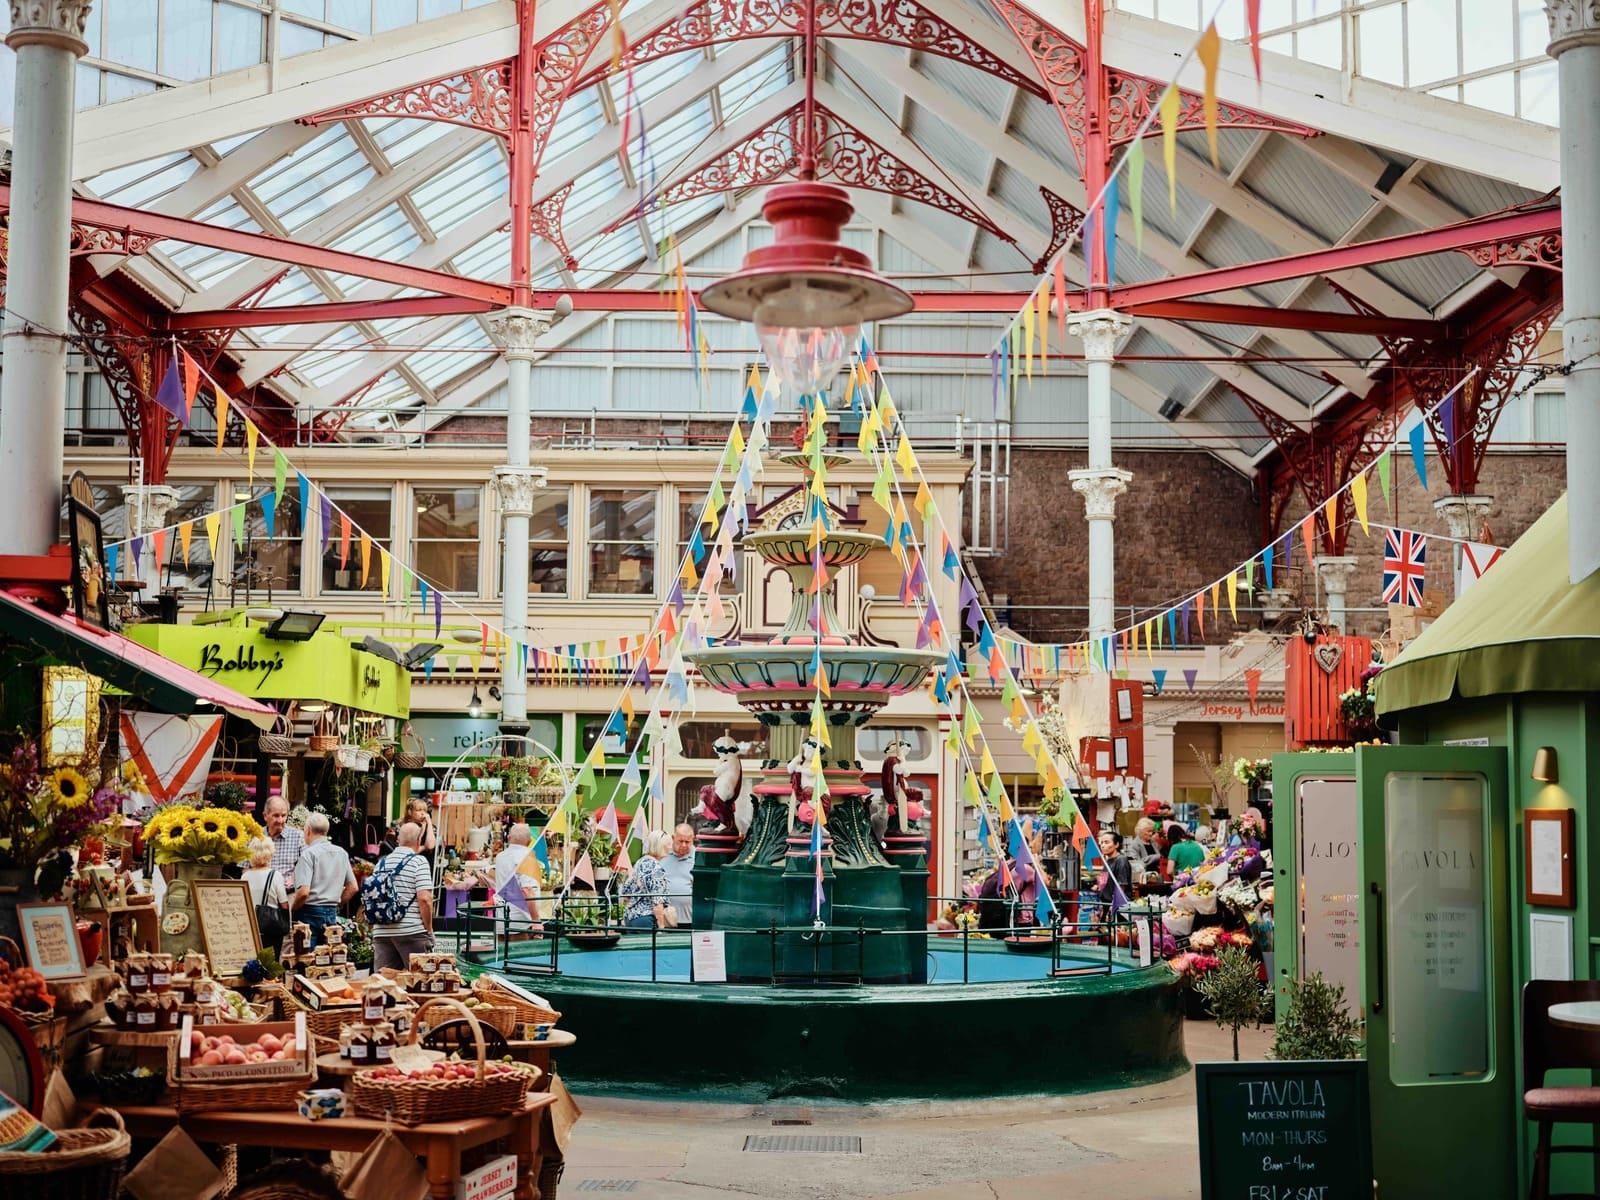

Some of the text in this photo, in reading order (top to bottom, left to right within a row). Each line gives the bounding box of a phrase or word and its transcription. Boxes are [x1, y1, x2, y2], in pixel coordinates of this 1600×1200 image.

[197, 643, 284, 690] Bobby's
[1200, 701, 1242, 720] Jersey
[1238, 1079, 1326, 1107] TAVOLA
[1247, 1109, 1326, 1120] MODERN ITALIAN
[1249, 1184, 1277, 1200] FRI
[1296, 1185, 1329, 1200] SAT
